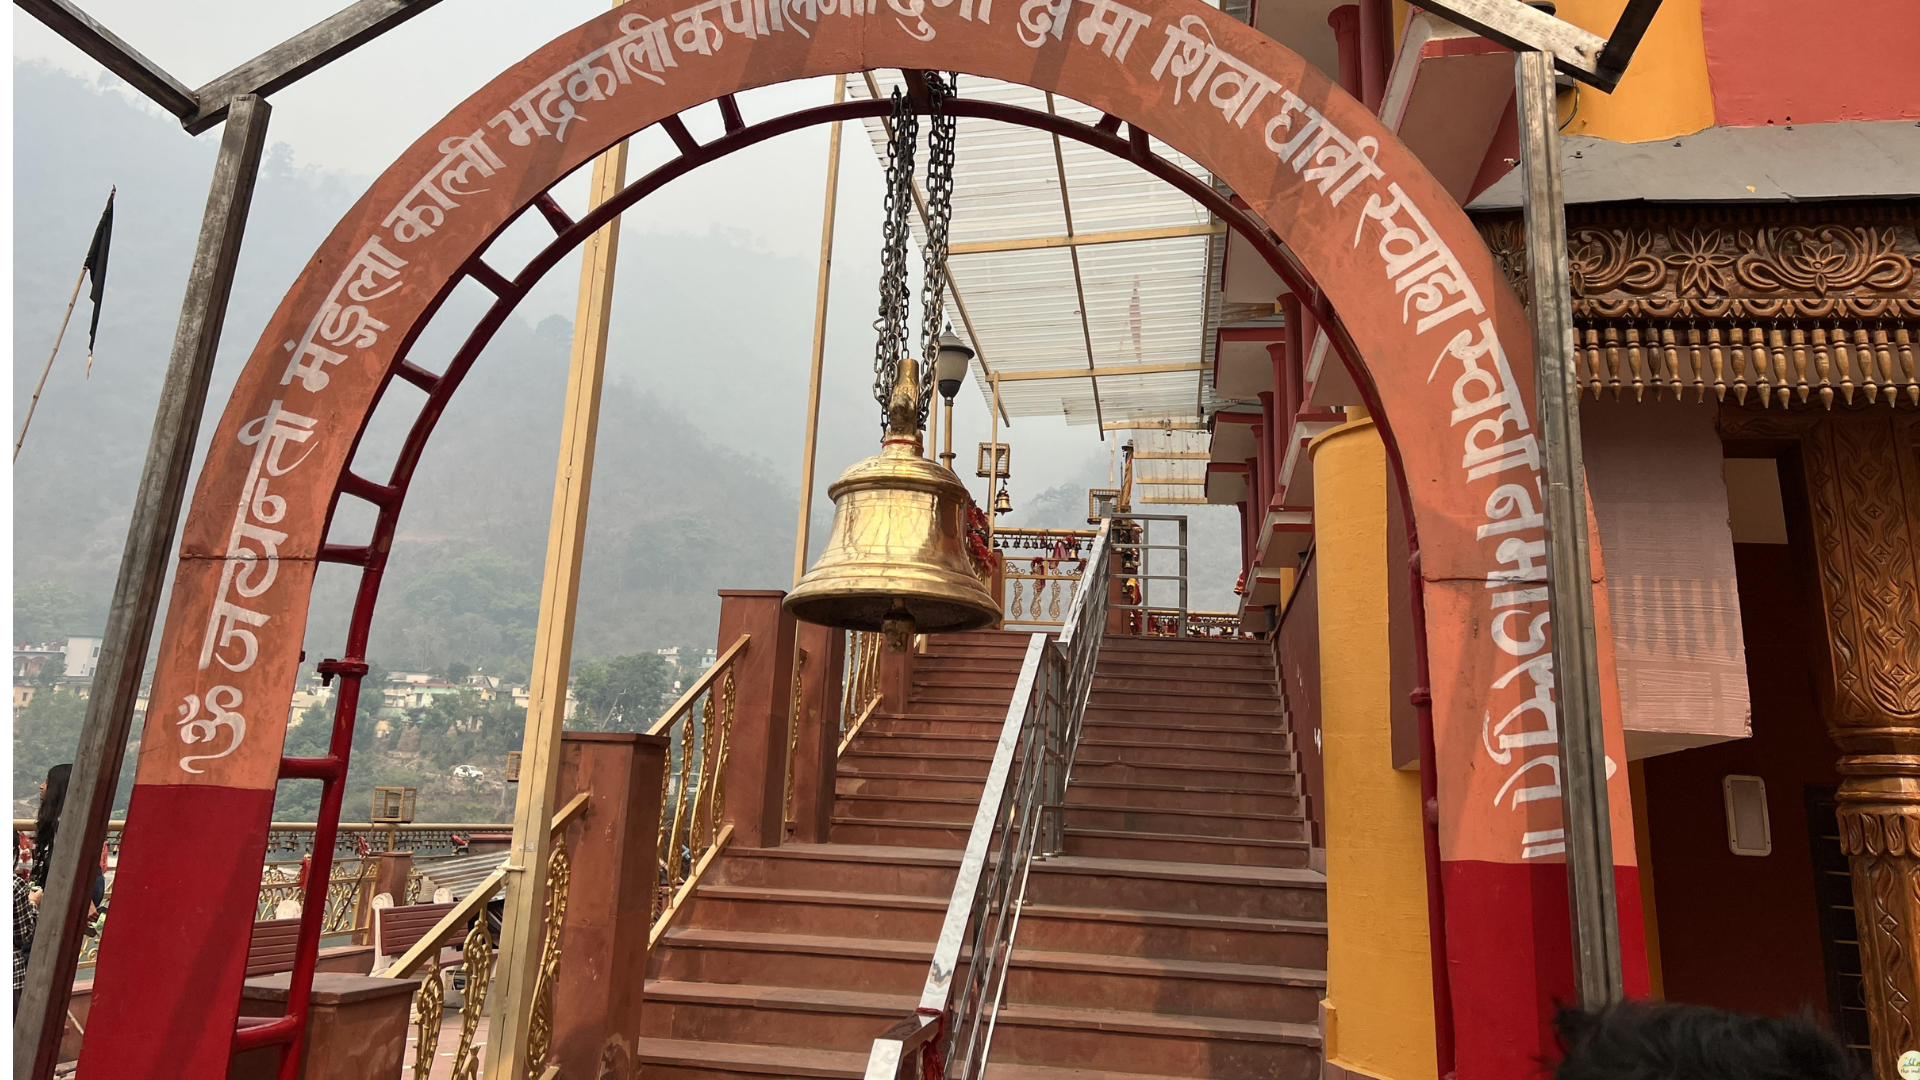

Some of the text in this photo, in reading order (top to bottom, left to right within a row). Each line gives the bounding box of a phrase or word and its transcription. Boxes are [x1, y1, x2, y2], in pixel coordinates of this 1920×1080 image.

[488, 12, 678, 148] भद्रकाली
[1149, 14, 1283, 130] शिवा
[380, 128, 507, 243] काली
[1353, 182, 1486, 336] स्वाहा
[1426, 318, 1542, 484] स्वधा
[198, 399, 319, 673] जयन्ती
[176, 684, 247, 774] ॐ
